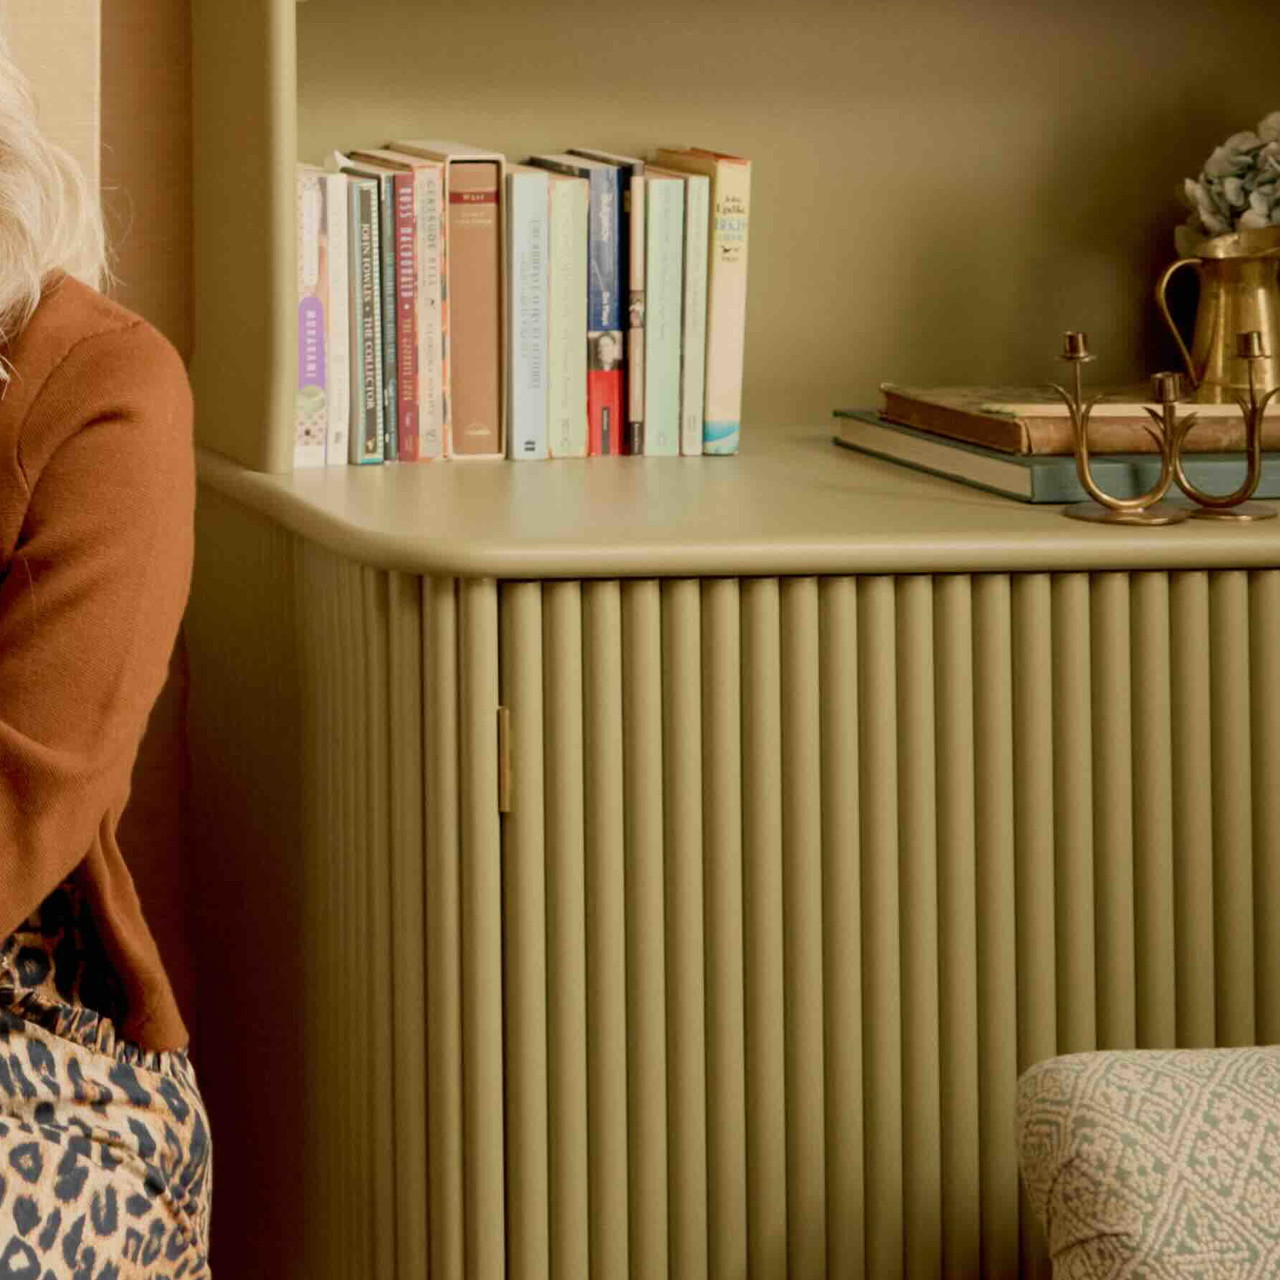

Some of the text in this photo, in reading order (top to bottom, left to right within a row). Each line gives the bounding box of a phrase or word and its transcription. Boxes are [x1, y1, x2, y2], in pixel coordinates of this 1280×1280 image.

[399, 187, 413, 218] ROSS
[426, 180, 437, 250] GERTRUDE
[304, 310, 317, 378] MURAKAMI
[360, 223, 376, 410] JOHN FOWLES THE COLLECTOR
